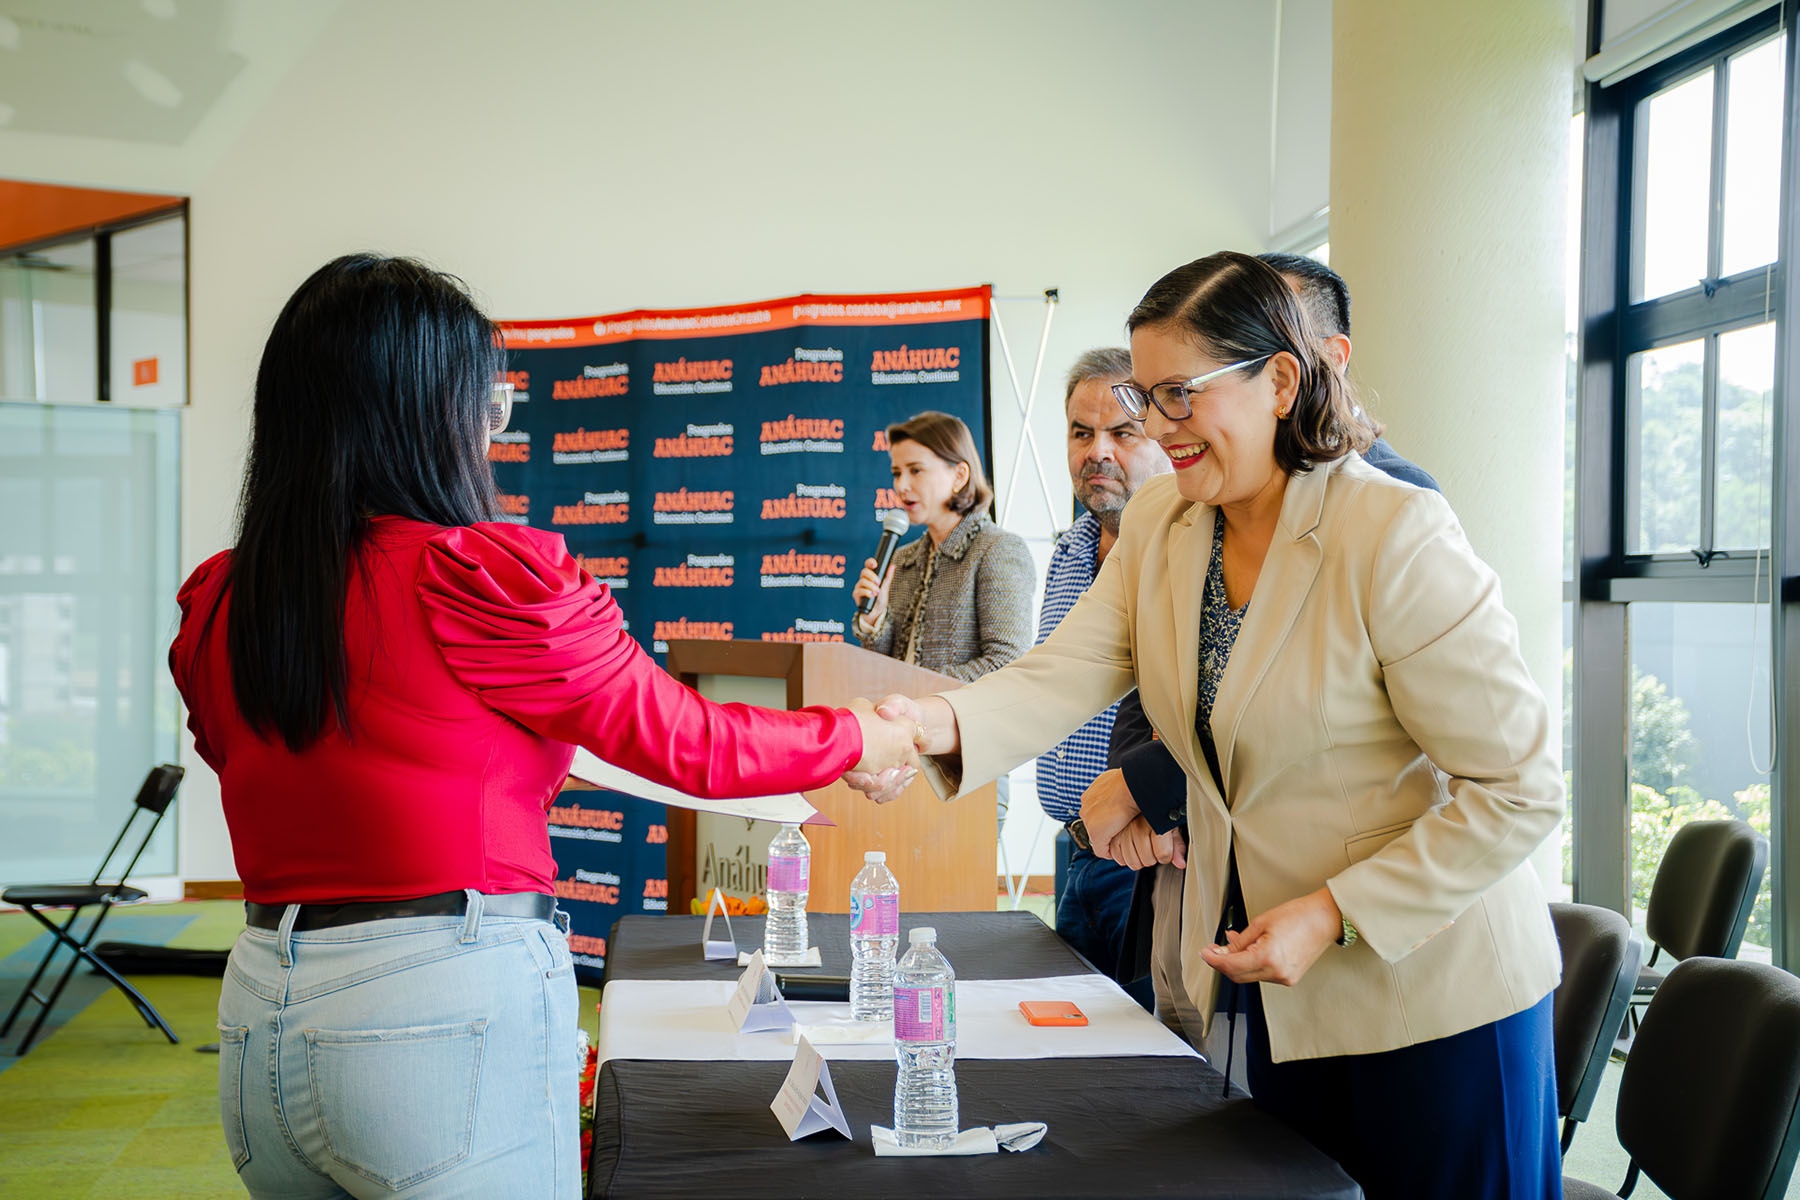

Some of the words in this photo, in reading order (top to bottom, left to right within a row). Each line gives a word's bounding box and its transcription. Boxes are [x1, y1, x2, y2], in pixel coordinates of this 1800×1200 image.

[795, 347, 843, 363] Posgrados
[871, 344, 960, 371] ANÁHUAC
[653, 357, 733, 382] ANÁHUAC
[759, 357, 844, 387] ANÁHUAC
[918, 370, 960, 384] Continua
[552, 375, 629, 401] ANÁHUAC
[552, 427, 630, 452] ANÁHUAC
[760, 414, 844, 442] ANÁHUAC
[653, 433, 734, 458] ANÁHUAC
[653, 487, 734, 511] ANÁHUAC
[760, 493, 846, 520] ANÁHUAC
[551, 501, 630, 525] ANÁHUAC
[653, 563, 734, 587] ANÁHUAC
[760, 549, 846, 576] ANÁHUAC
[653, 616, 734, 641] ANÁHUAC
